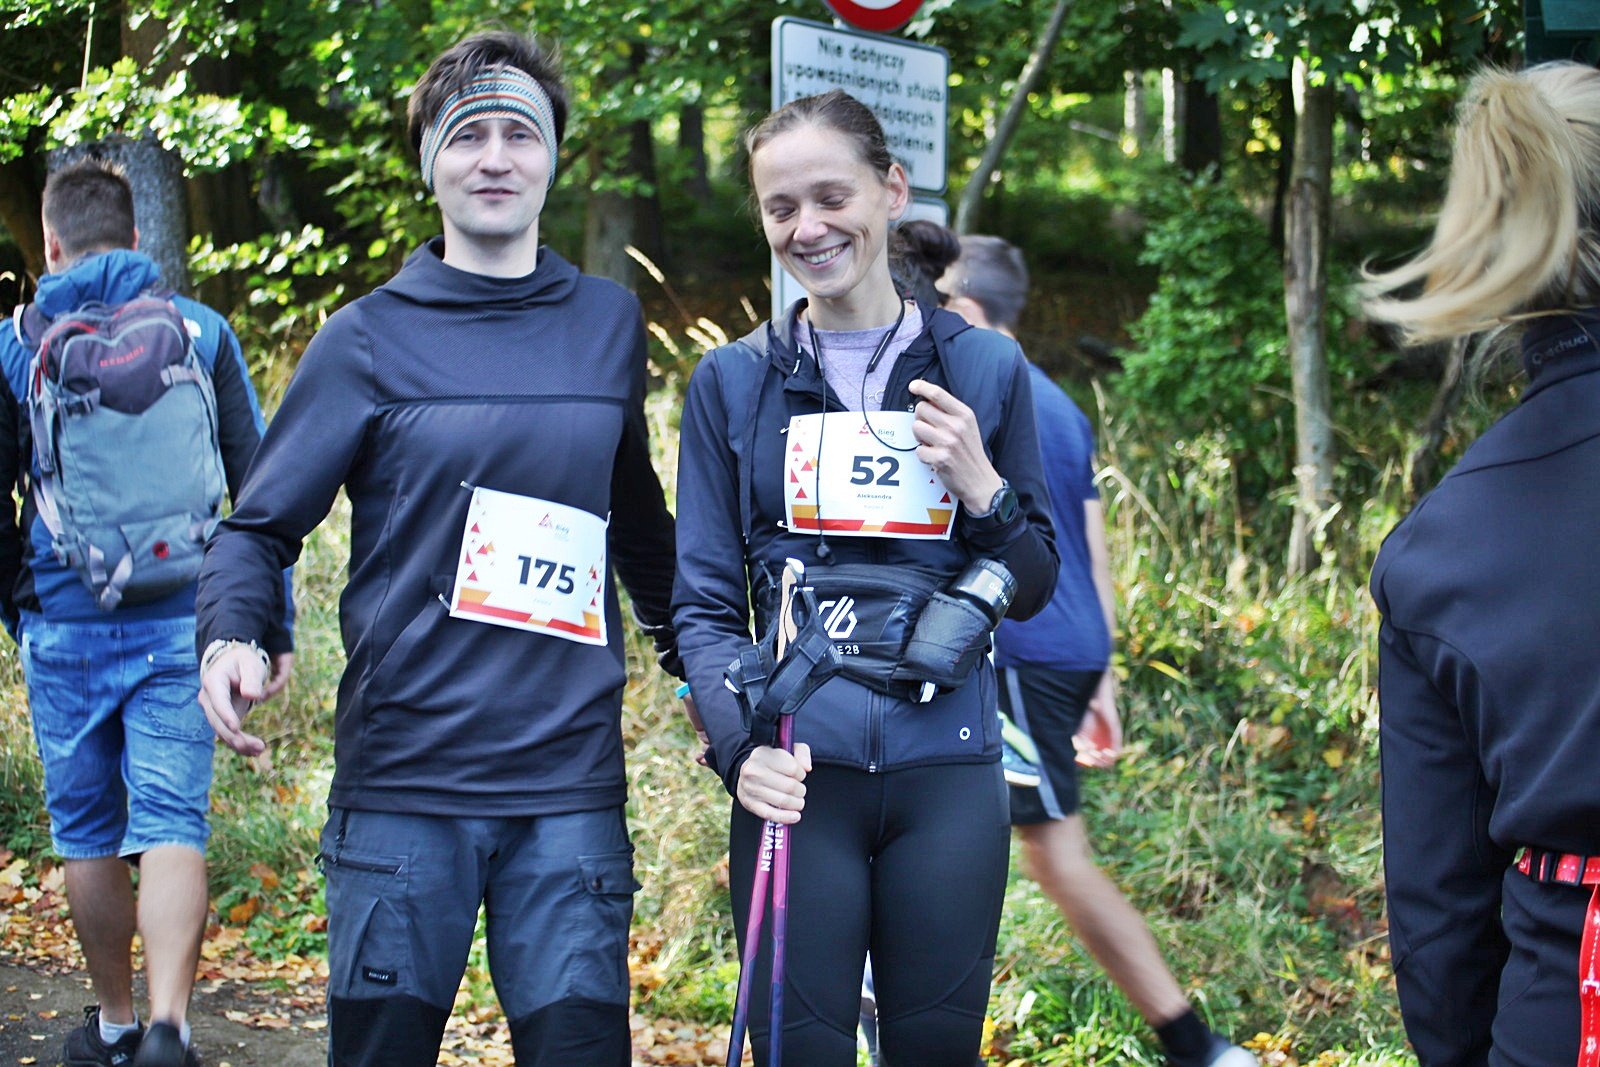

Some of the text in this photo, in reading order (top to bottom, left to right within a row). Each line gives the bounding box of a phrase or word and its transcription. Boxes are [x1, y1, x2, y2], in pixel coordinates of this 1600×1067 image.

[818, 36, 906, 73] Nie dotyczy
[873, 102, 935, 130] dających
[885, 132, 935, 153] wolenie
[850, 456, 900, 486] 52
[517, 554, 575, 595] 175
[837, 644, 860, 655] E2B
